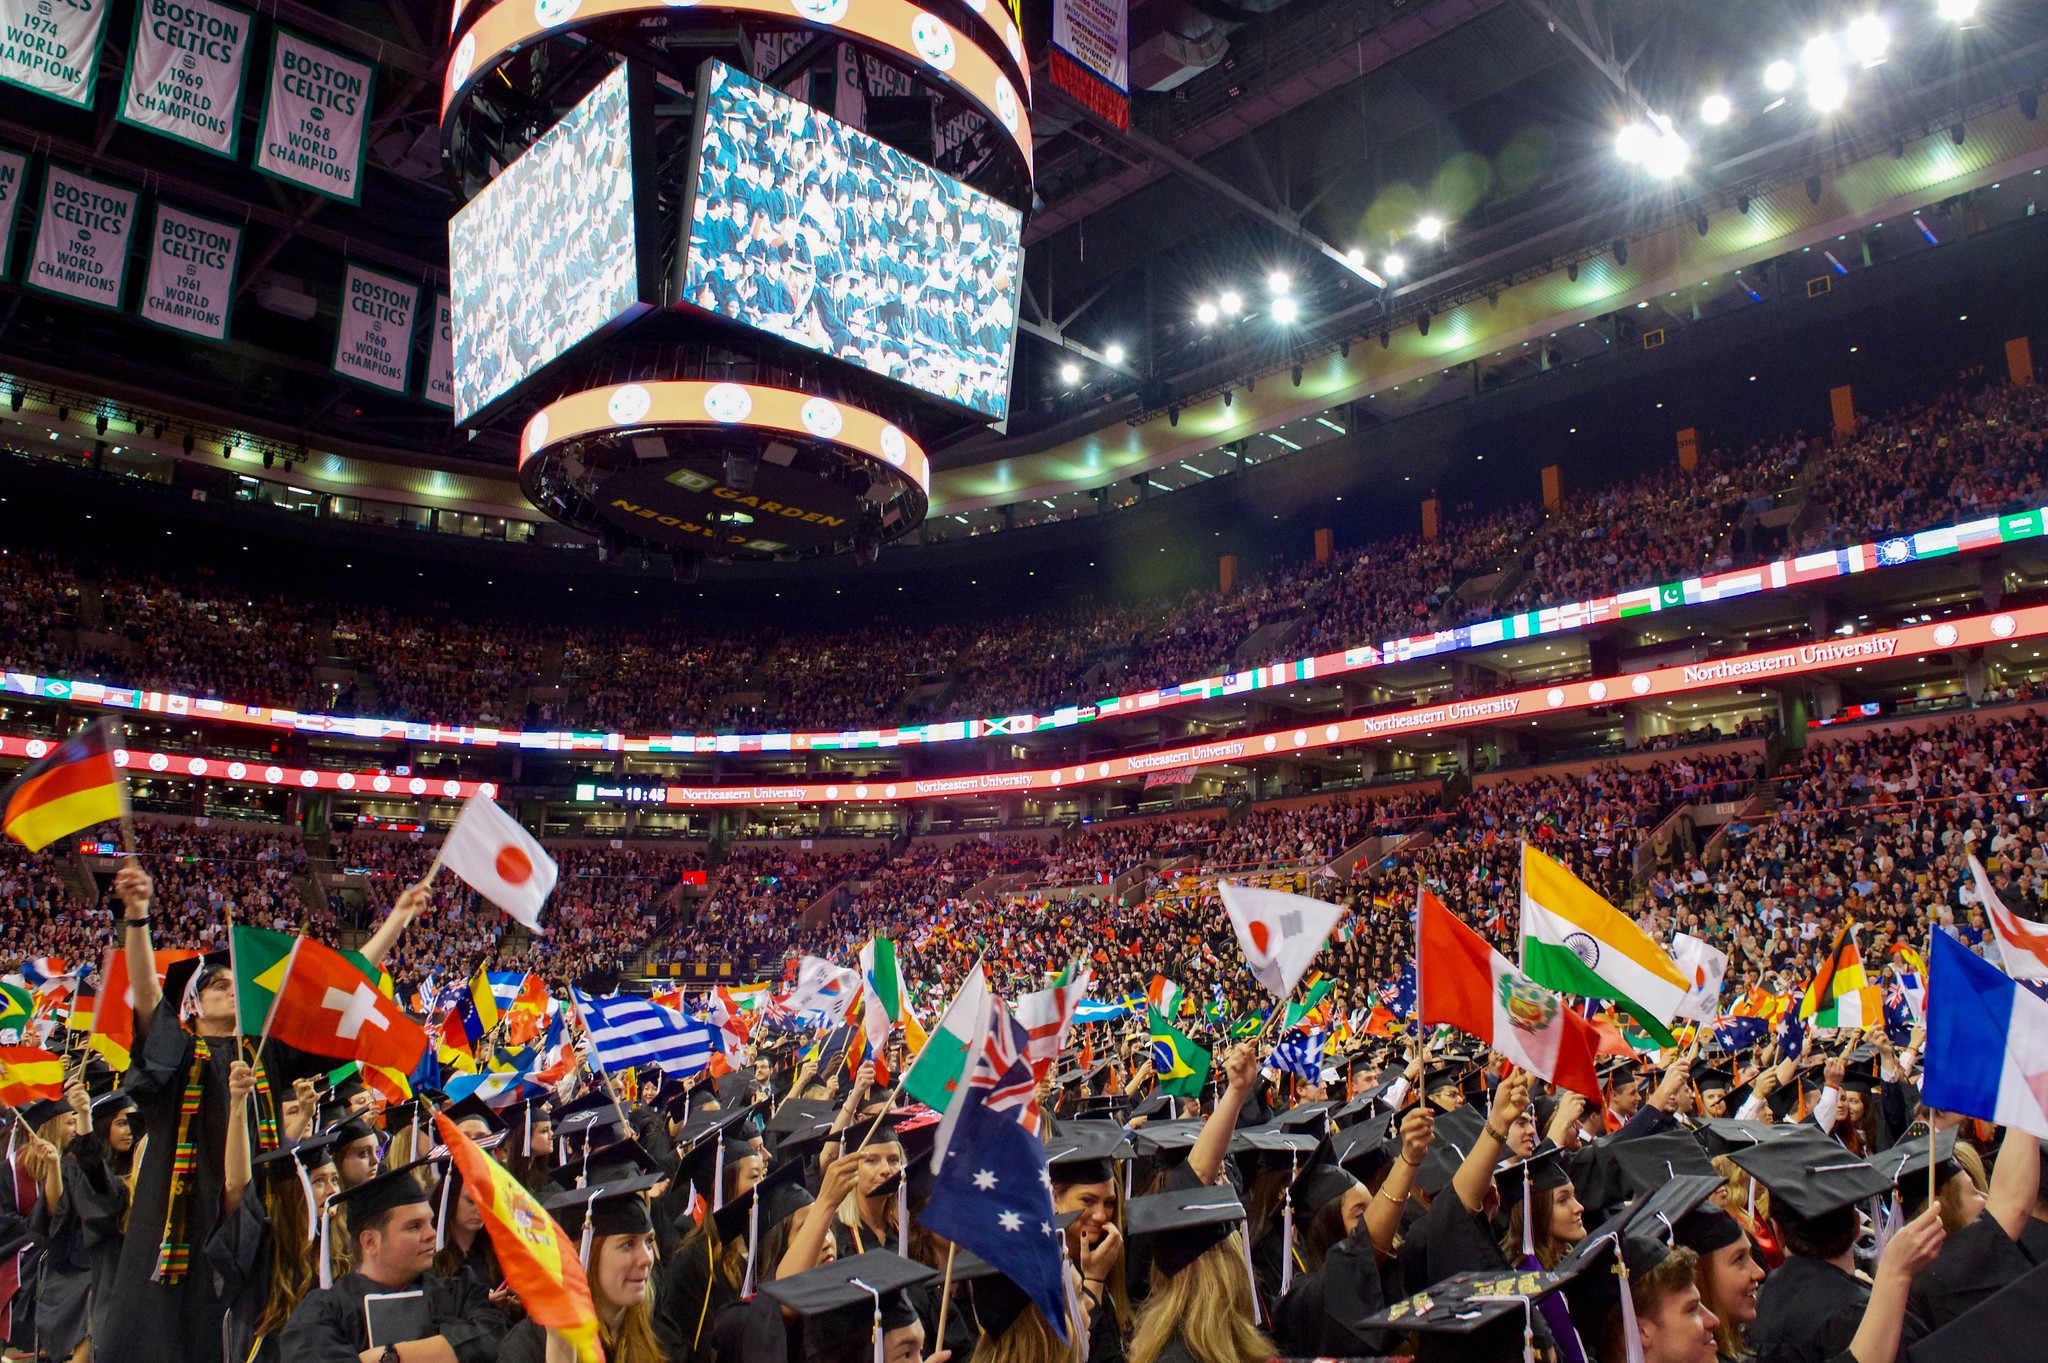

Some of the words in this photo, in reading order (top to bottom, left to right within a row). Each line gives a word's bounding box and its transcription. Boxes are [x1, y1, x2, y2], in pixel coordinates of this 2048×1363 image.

[24, 13, 58, 37] 1974
[152, 0, 238, 44] BOSTON
[7, 26, 67, 59] WORLD
[153, 21, 231, 63] CELTICS
[1071, 36, 1111, 68] PROVIDENCE
[171, 68, 203, 89] 1969
[283, 50, 361, 96] BOSTON
[845, 45, 907, 93] BSTON
[158, 81, 211, 111] WORLD
[283, 74, 356, 116] CELTICS
[136, 93, 226, 134] CHAMPIONS
[288, 131, 337, 160] WORLD
[300, 119, 330, 142] 1968
[269, 143, 350, 182] CHAMPIONS
[53, 181, 127, 218] BOSTON
[53, 202, 121, 235] CELTICS
[69, 240, 96, 258] 1962
[162, 219, 231, 253] BOSTON
[57, 251, 103, 274] WORLD
[162, 239, 225, 270] CELTICS
[38, 261, 115, 291] CHAMPIONS
[177, 275, 200, 291] 1961
[166, 286, 209, 308] WORLD
[352, 278, 410, 311] BOSTON
[149, 296, 220, 326] CHAMPIONS
[352, 297, 405, 326] CELTICS
[355, 341, 391, 363] WORLD
[365, 331, 387, 348] 1960
[341, 352, 402, 380] CHAMPIONS
[677, 471, 708, 488] TD
[712, 487, 846, 527] GARDEN
[1683, 652, 1797, 683] Northeastern
[1799, 636, 1897, 665] University
[1363, 710, 1445, 733] Northeastern
[1448, 698, 1519, 719] University
[1951, 713, 1976, 727] 143
[1128, 753, 1189, 770] Northeastern
[1191, 743, 1244, 759] University
[682, 788, 750, 801] Northeastern
[753, 787, 807, 801] University
[915, 780, 978, 793] Northeastern
[980, 774, 1033, 787] University
